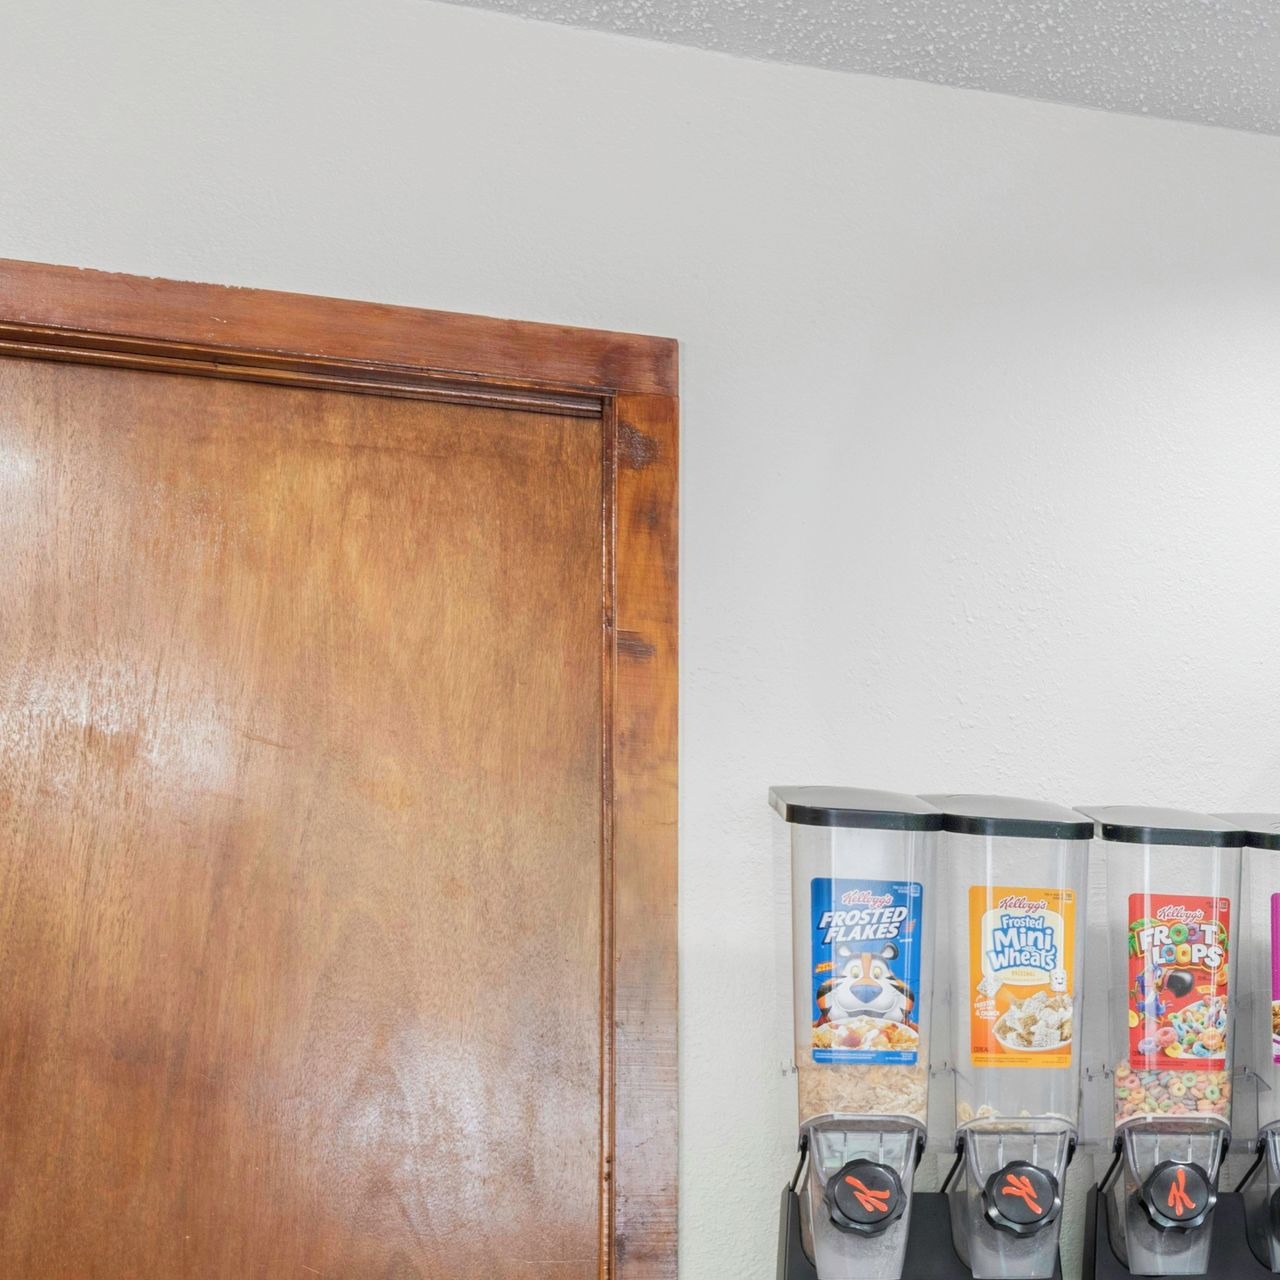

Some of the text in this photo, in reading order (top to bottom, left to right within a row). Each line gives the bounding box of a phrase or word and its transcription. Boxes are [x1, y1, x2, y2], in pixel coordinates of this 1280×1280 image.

[841, 889, 894, 909] Kellogg's
[999, 896, 1047, 914] Kellogg's
[819, 906, 909, 928] FROSTED
[1001, 915, 1045, 929] Frosted
[1157, 905, 1205, 922] Kellogg's
[823, 922, 901, 945] FLAKES
[993, 928, 1054, 952] Mini
[1139, 923, 1219, 951] FROOT
[988, 945, 1057, 972] Wheats
[1151, 943, 1224, 968] LOOPS
